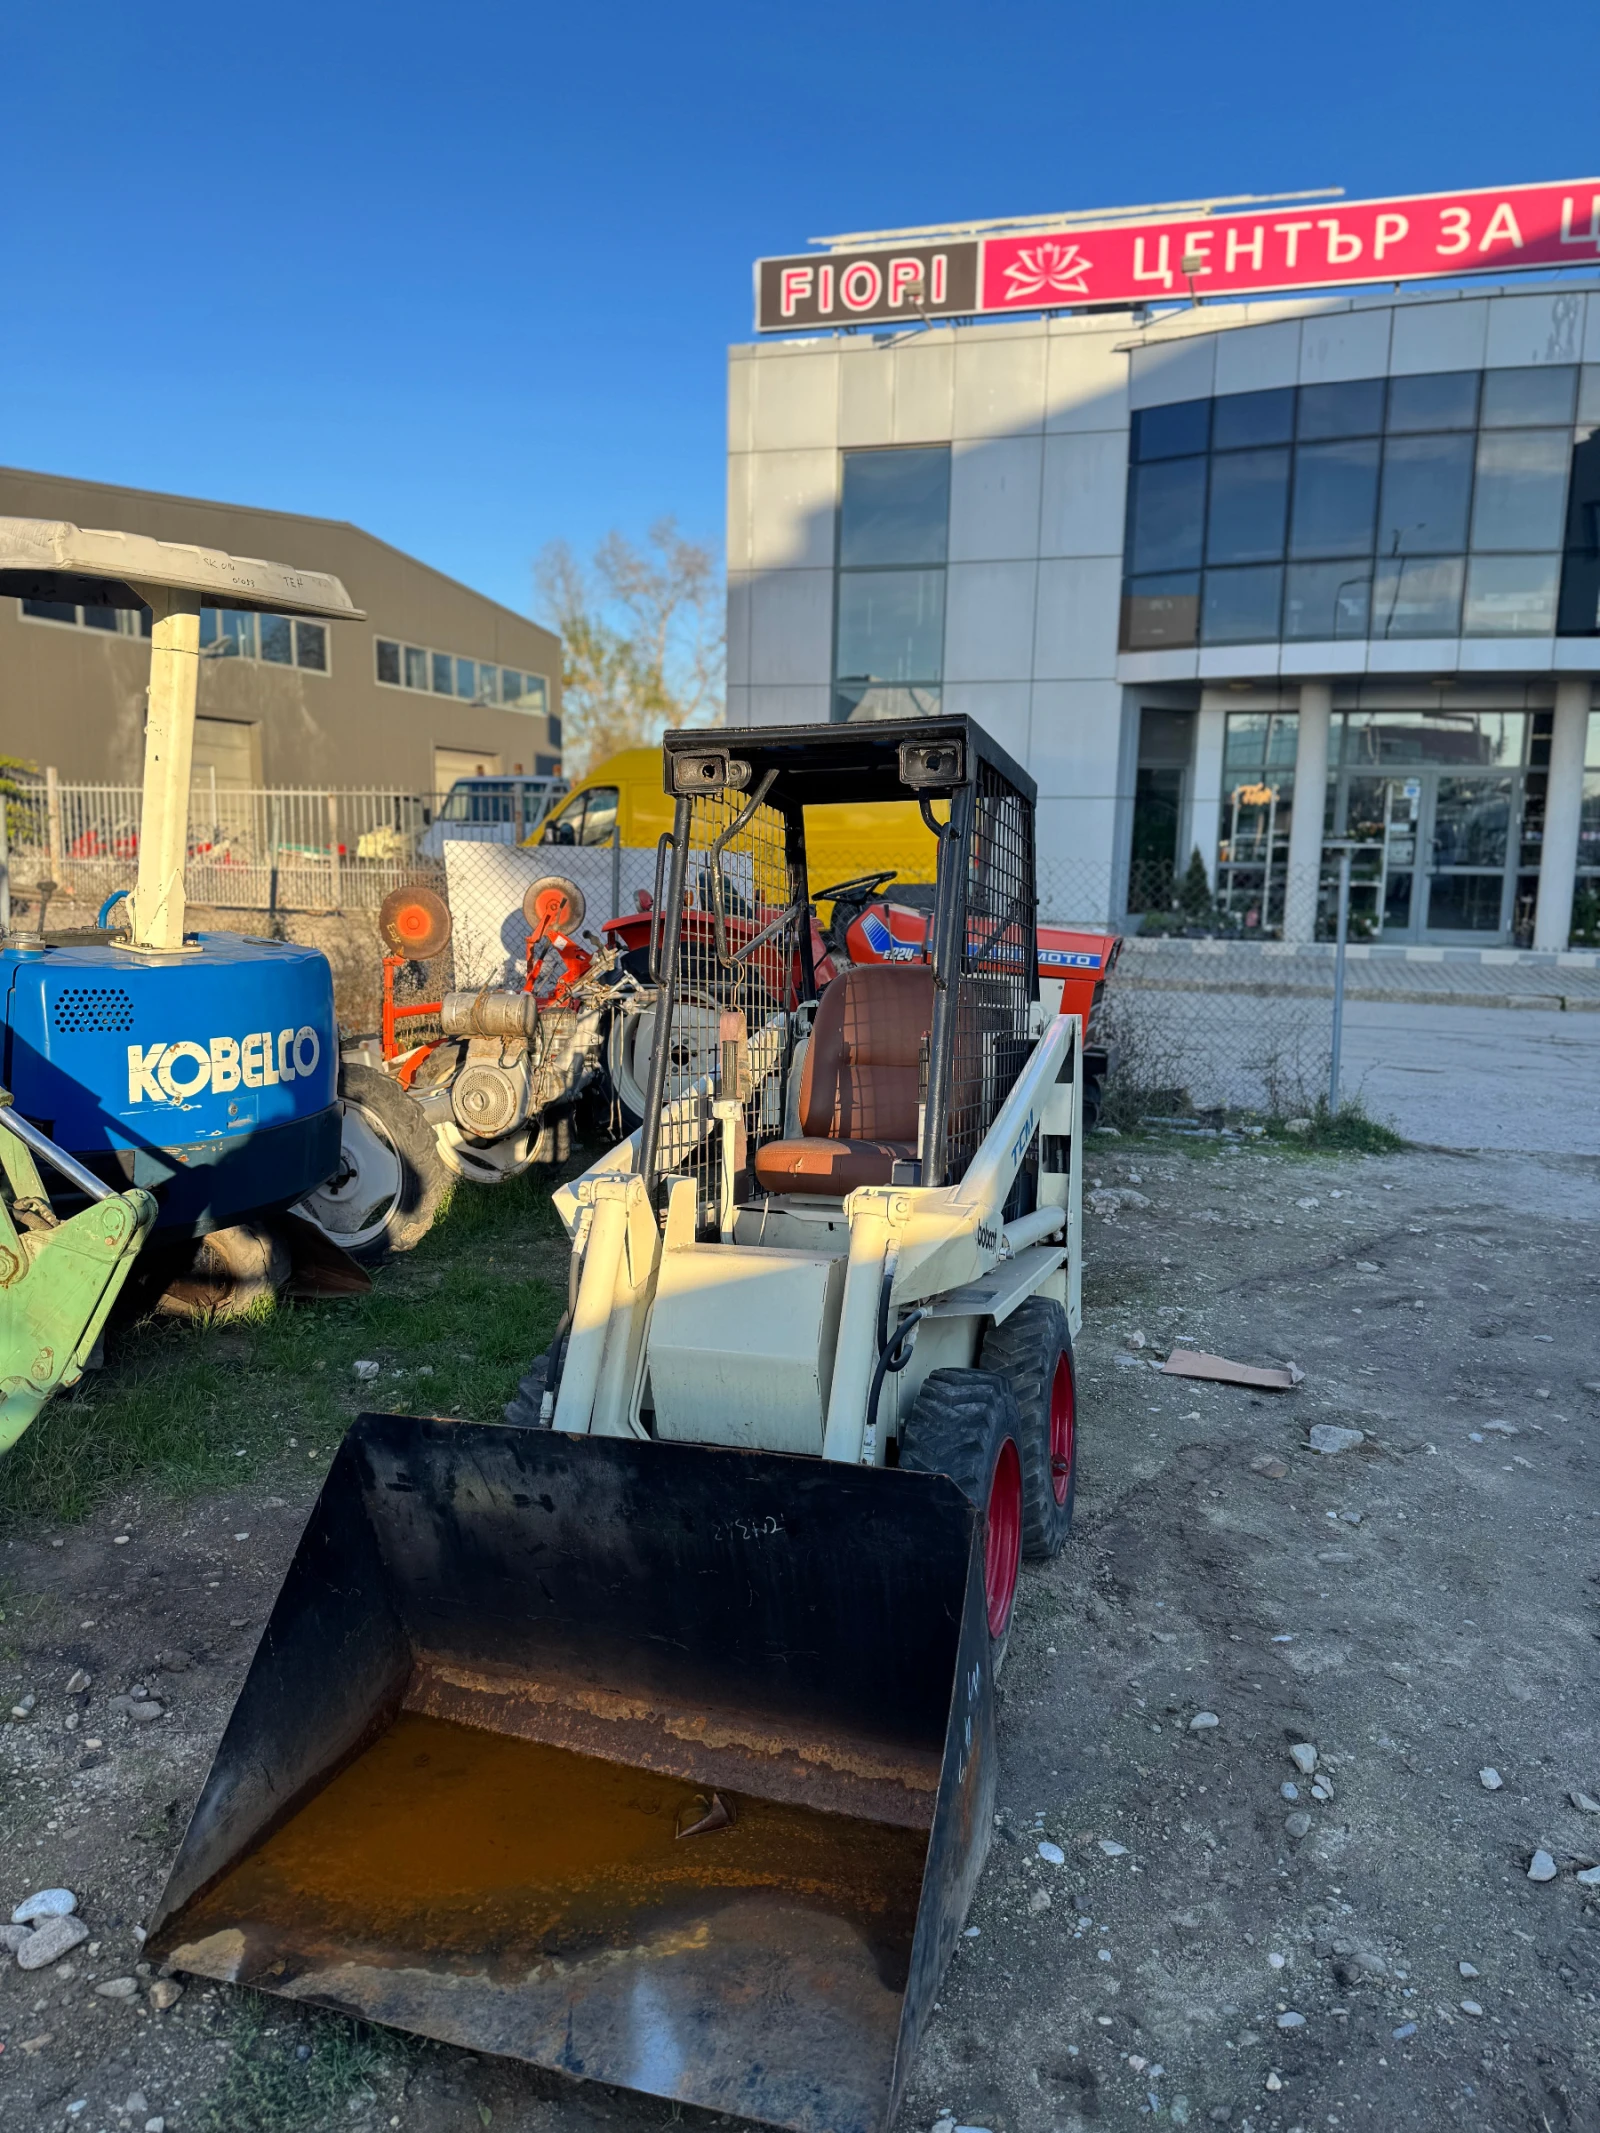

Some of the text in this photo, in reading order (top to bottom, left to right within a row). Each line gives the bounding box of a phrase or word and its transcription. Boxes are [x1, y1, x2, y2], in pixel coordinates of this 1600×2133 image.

[1133, 213, 1409, 289] ЦЕНТЪР
[1436, 202, 1524, 255] ЗА
[780, 254, 948, 317] FIORI
[883, 947, 914, 961] E224
[127, 1025, 320, 1104] KOBELCO
